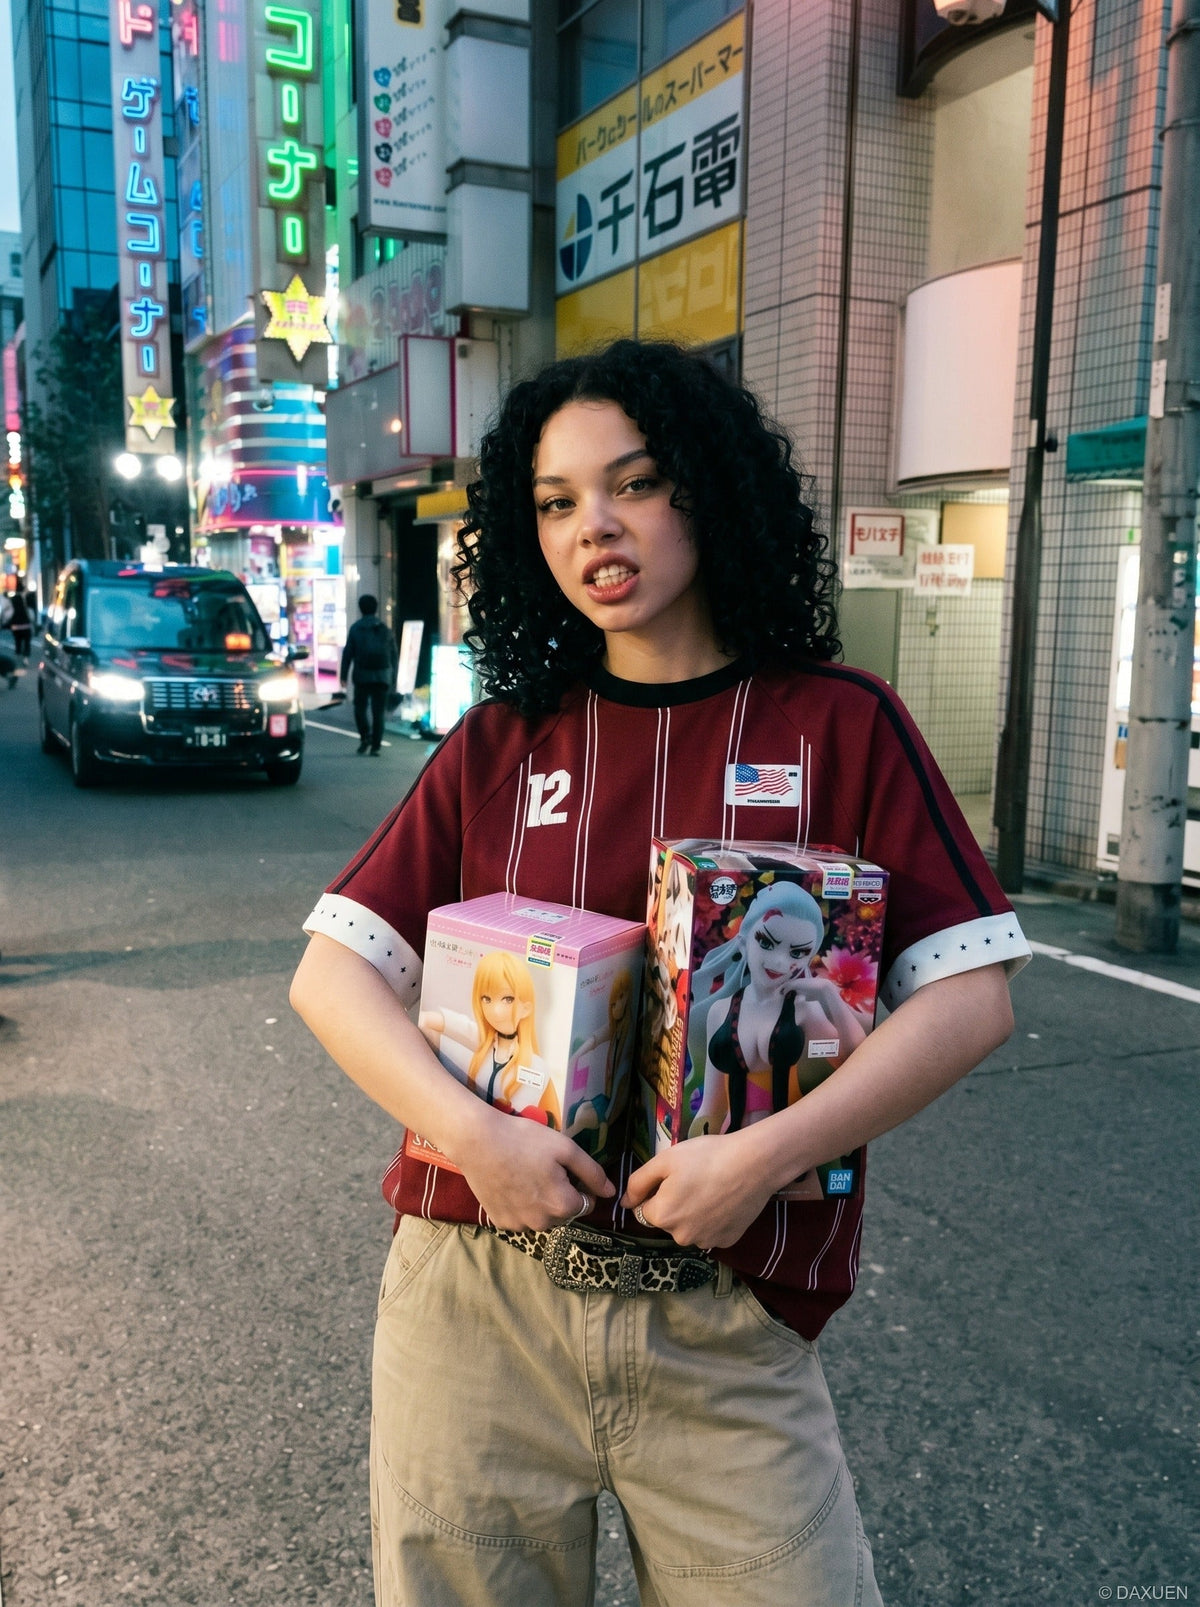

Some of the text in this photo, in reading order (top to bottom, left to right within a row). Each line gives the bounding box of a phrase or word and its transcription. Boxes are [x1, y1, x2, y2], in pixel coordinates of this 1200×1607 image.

[264, 5, 317, 255] コーナー
[122, 77, 164, 373] ゲームコーナー
[597, 111, 740, 257] 千石電
[526, 769, 572, 828] 12
[829, 1181, 846, 1190] DAI
[830, 1172, 851, 1181] BAN
